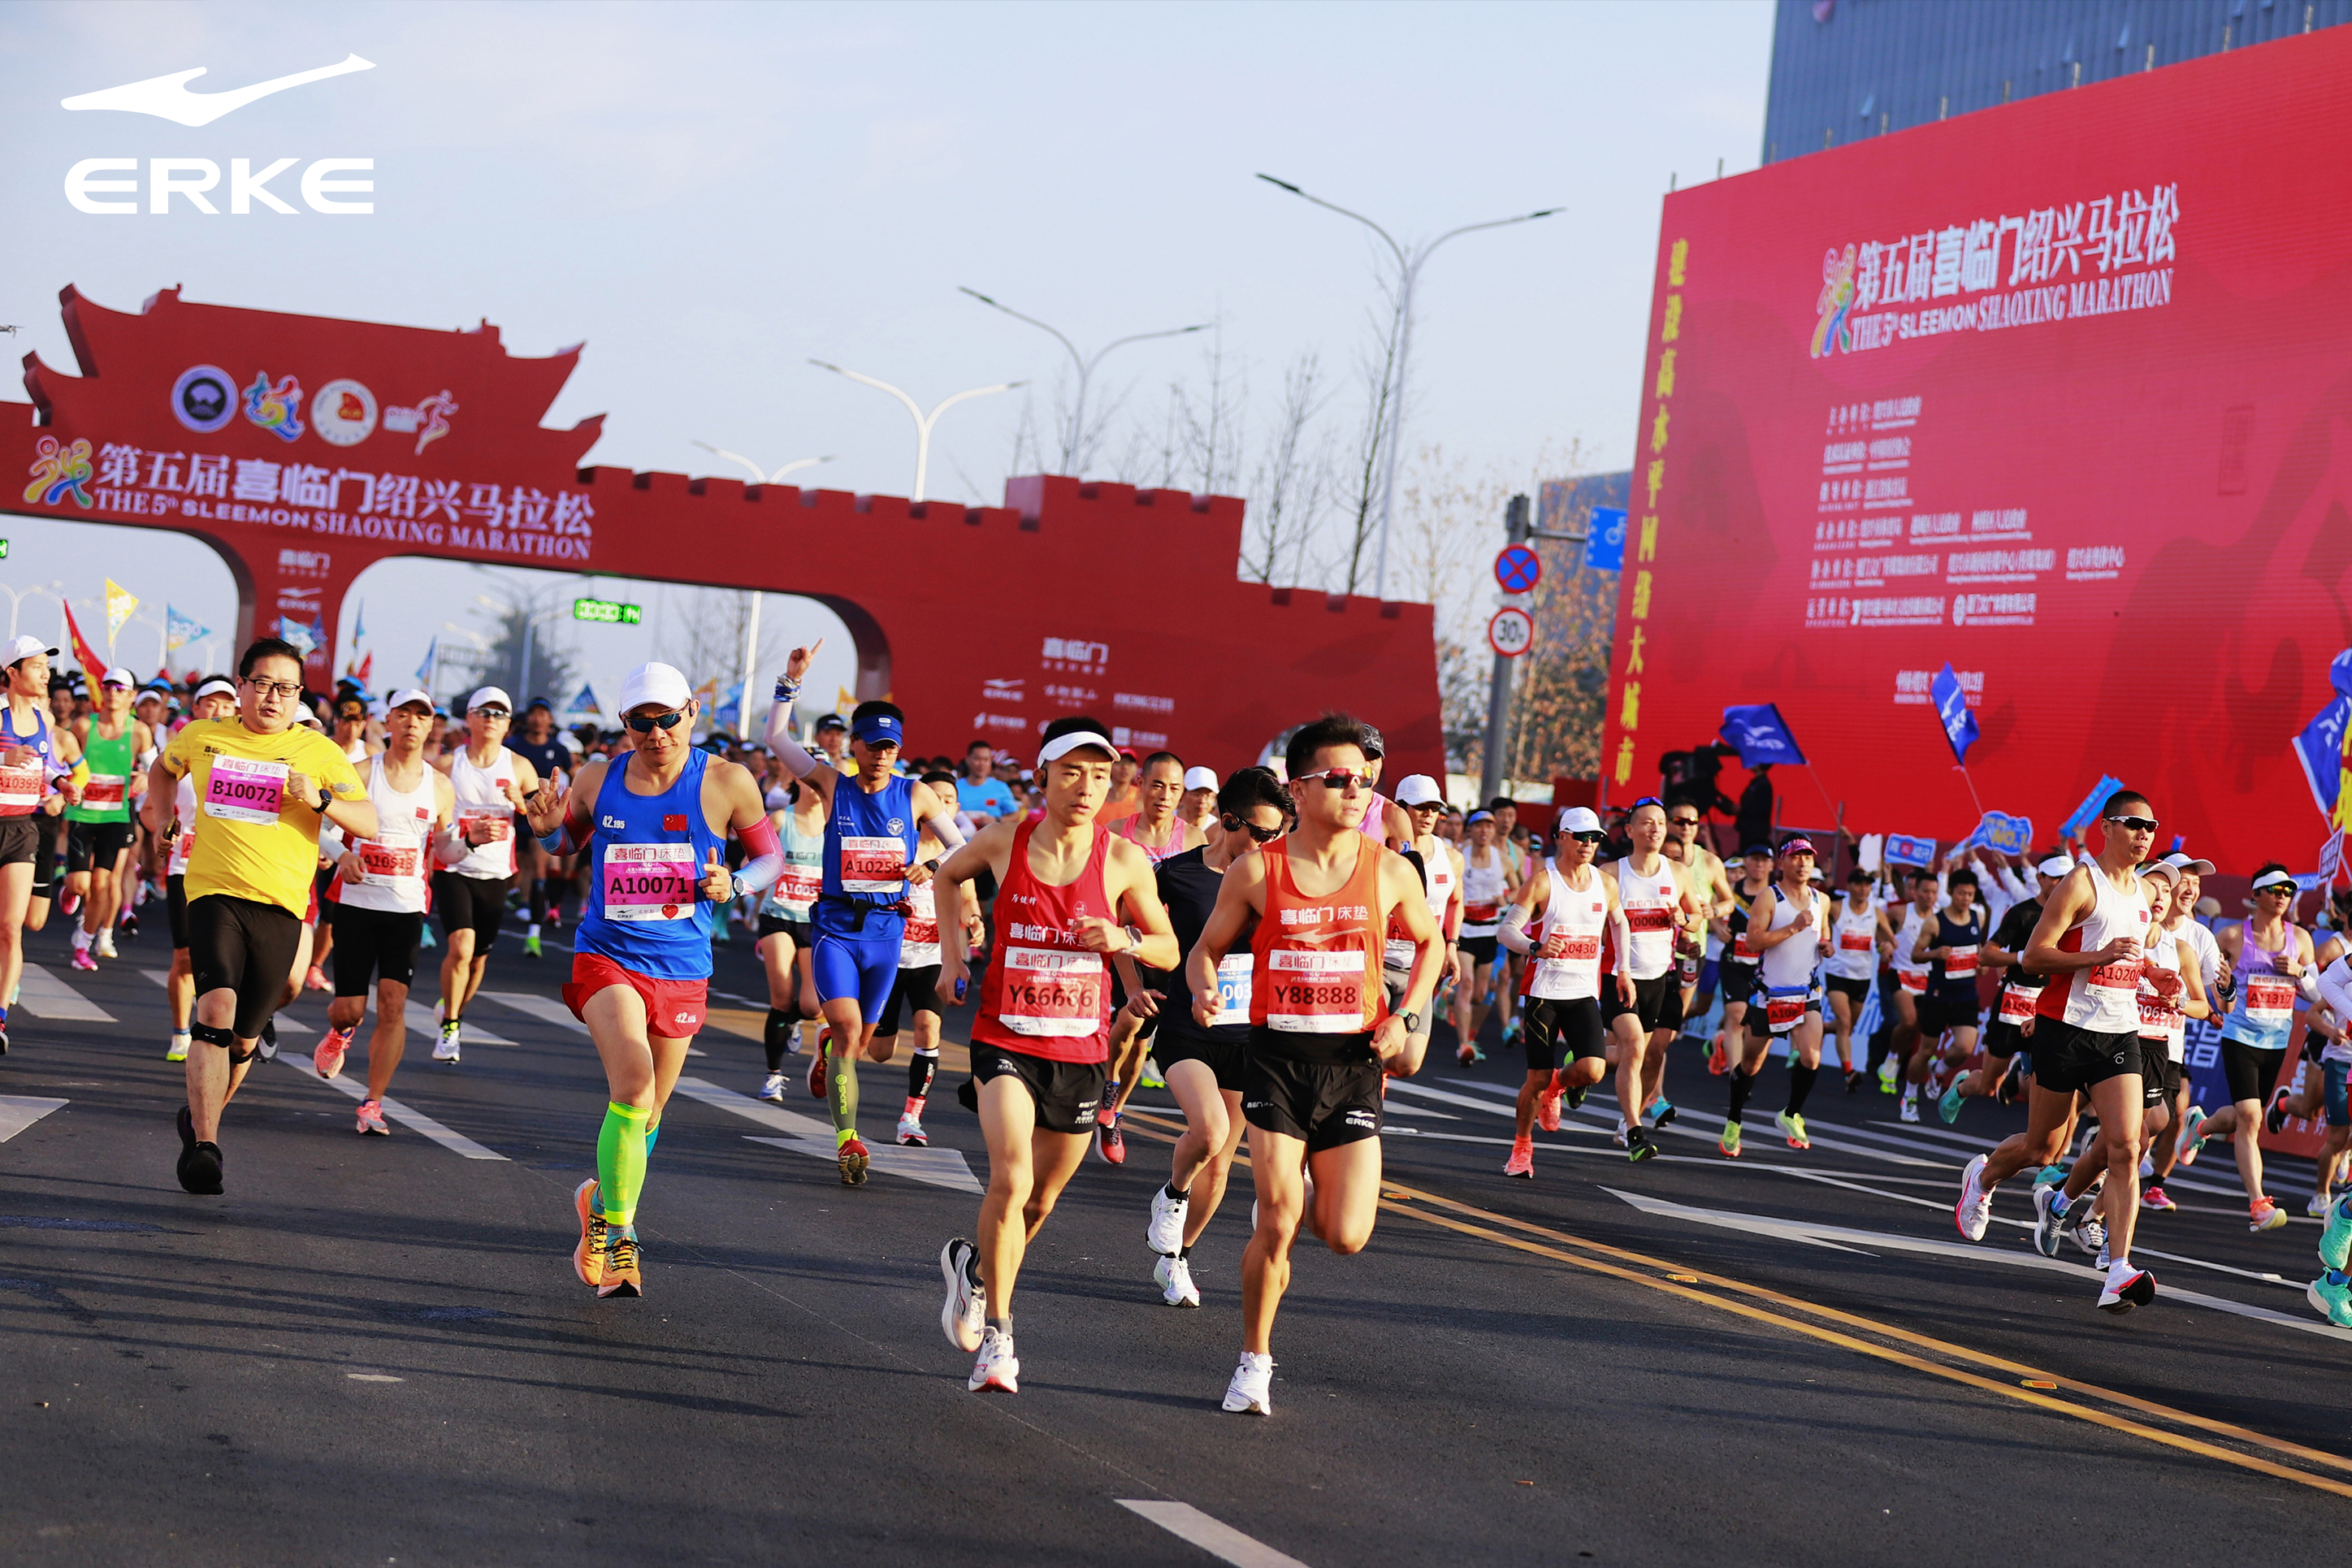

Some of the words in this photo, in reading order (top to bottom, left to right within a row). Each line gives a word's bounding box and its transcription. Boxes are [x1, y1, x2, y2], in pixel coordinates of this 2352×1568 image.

[1852, 181, 2181, 311] 第五届喜临门绍兴马拉松
[1899, 303, 1979, 340] SLEEMON
[1977, 283, 2068, 331] SHAOXING
[2067, 267, 2174, 318] MARATHON
[95, 443, 596, 538] 第五届喜临门绍兴马拉松
[93, 487, 149, 515] THE
[180, 499, 310, 529] SLEEMON
[312, 510, 444, 546] SHAOXING
[448, 525, 592, 560] MARATHON
[1042, 637, 1110, 665] 喜临门
[222, 758, 258, 773] 喜临门
[212, 780, 277, 803] B10072
[602, 815, 626, 829] 42.195
[614, 847, 657, 860] 喜临门
[660, 847, 687, 860] 床垫
[845, 860, 901, 874] A10259
[609, 877, 689, 894] A10071
[1280, 907, 1334, 925] 喜临门
[1337, 905, 1369, 920] 床垫
[1010, 922, 1059, 944] 喜临门
[1561, 943, 1596, 954] 10430
[1015, 952, 1063, 968] 喜临门
[1219, 957, 1240, 969] 临门
[1278, 955, 1325, 970] 喜临门
[1328, 955, 1354, 968] 床垫
[2094, 965, 2142, 982] A10200
[1009, 984, 1094, 1007] Y66666
[1274, 985, 1357, 1005] Y88888
[2138, 1004, 2168, 1020] 0065
